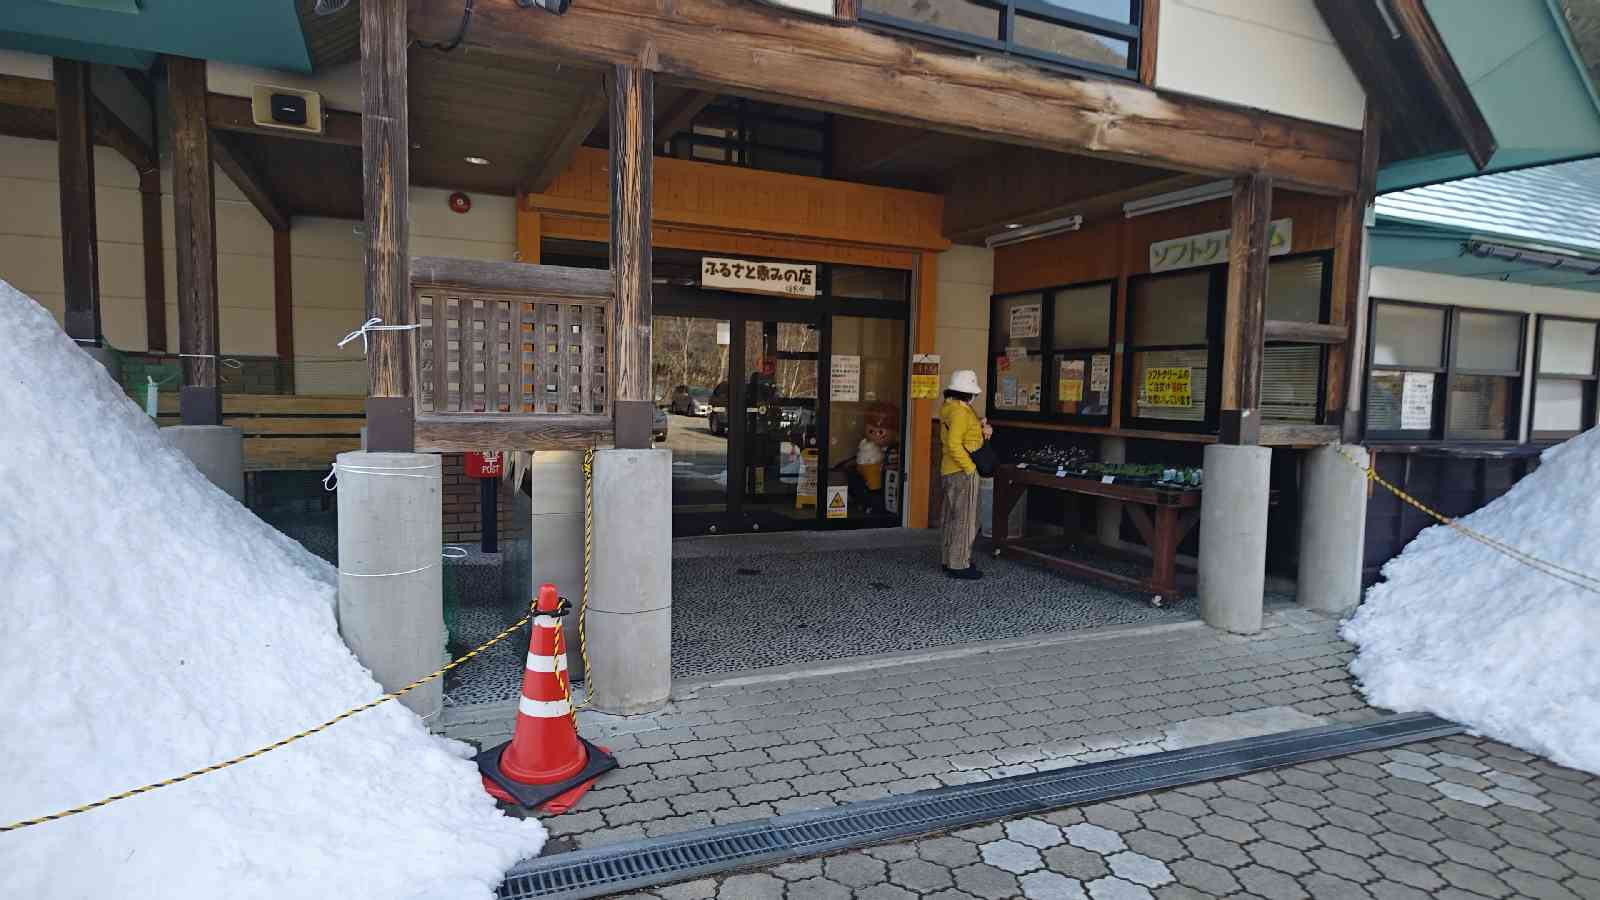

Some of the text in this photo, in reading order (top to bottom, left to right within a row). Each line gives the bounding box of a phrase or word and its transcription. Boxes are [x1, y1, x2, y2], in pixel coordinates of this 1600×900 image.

[1152, 221, 1287, 265] ソフトクム
[704, 261, 813, 285] ふるさと恵みの店
[481, 464, 501, 474] POST
